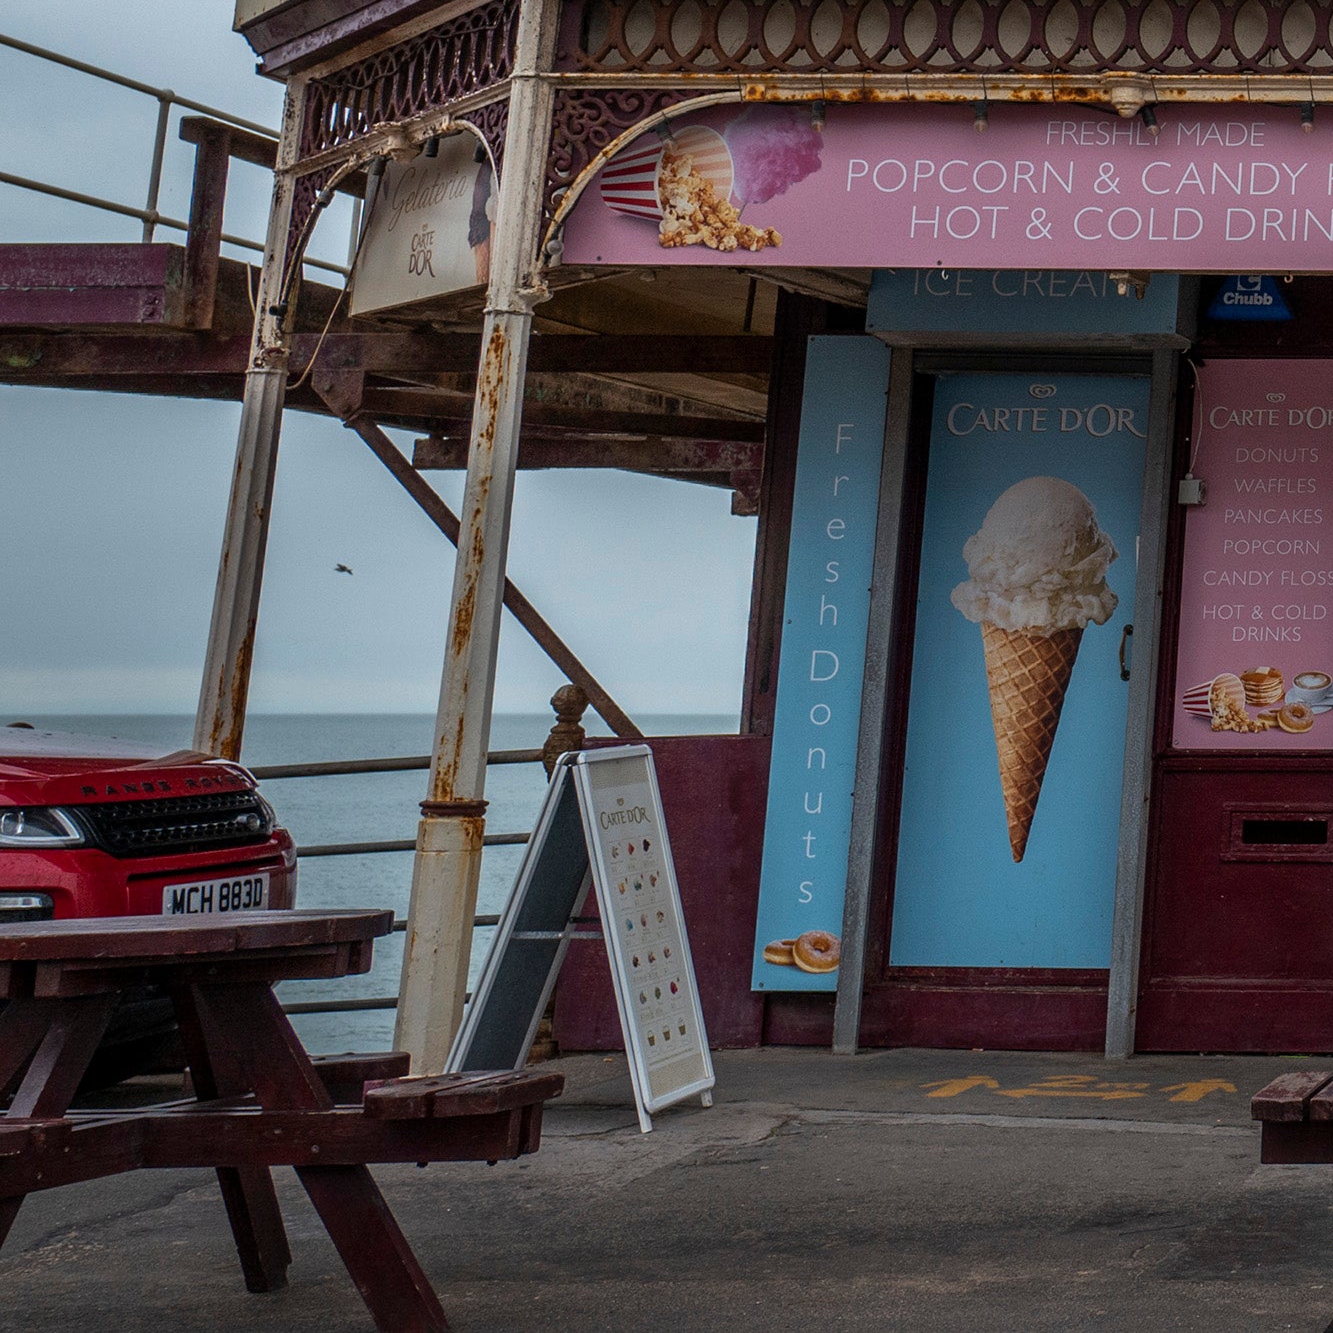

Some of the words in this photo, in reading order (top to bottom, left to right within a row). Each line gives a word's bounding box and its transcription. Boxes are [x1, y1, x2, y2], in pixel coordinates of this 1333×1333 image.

[1046, 121, 1167, 146] FRESHLY
[1175, 121, 1266, 148] MADE
[846, 159, 1074, 194] POPCORN
[1093, 161, 1121, 195] &
[1140, 161, 1313, 197] CANDY
[387, 168, 468, 232] Gelateria
[909, 205, 1009, 239] HOT
[1026, 207, 1053, 241] &
[1073, 206, 1204, 242] COLD
[411, 230, 436, 253] CARTE
[913, 269, 973, 296] ICE
[1223, 291, 1273, 306] Chubb
[946, 402, 1049, 437] CARTE
[1058, 403, 1148, 439] D'OR
[1209, 406, 1280, 430] CARTE
[1235, 447, 1319, 463] DONUTS
[1234, 478, 1317, 494] WAFFLES
[820, 423, 855, 626] Fresh
[1223, 509, 1324, 525] PANCAKES
[1223, 539, 1320, 555] POPCORN
[1203, 570, 1275, 586] CANDY
[1202, 604, 1245, 620] HOT
[1251, 605, 1264, 620] &
[1271, 604, 1327, 620] COLD
[1232, 626, 1302, 642] DRINKS
[798, 649, 840, 905] Donuts
[600, 810, 627, 830] CARTE
[172, 883, 213, 915] MCH
[218, 877, 263, 913] 883D
